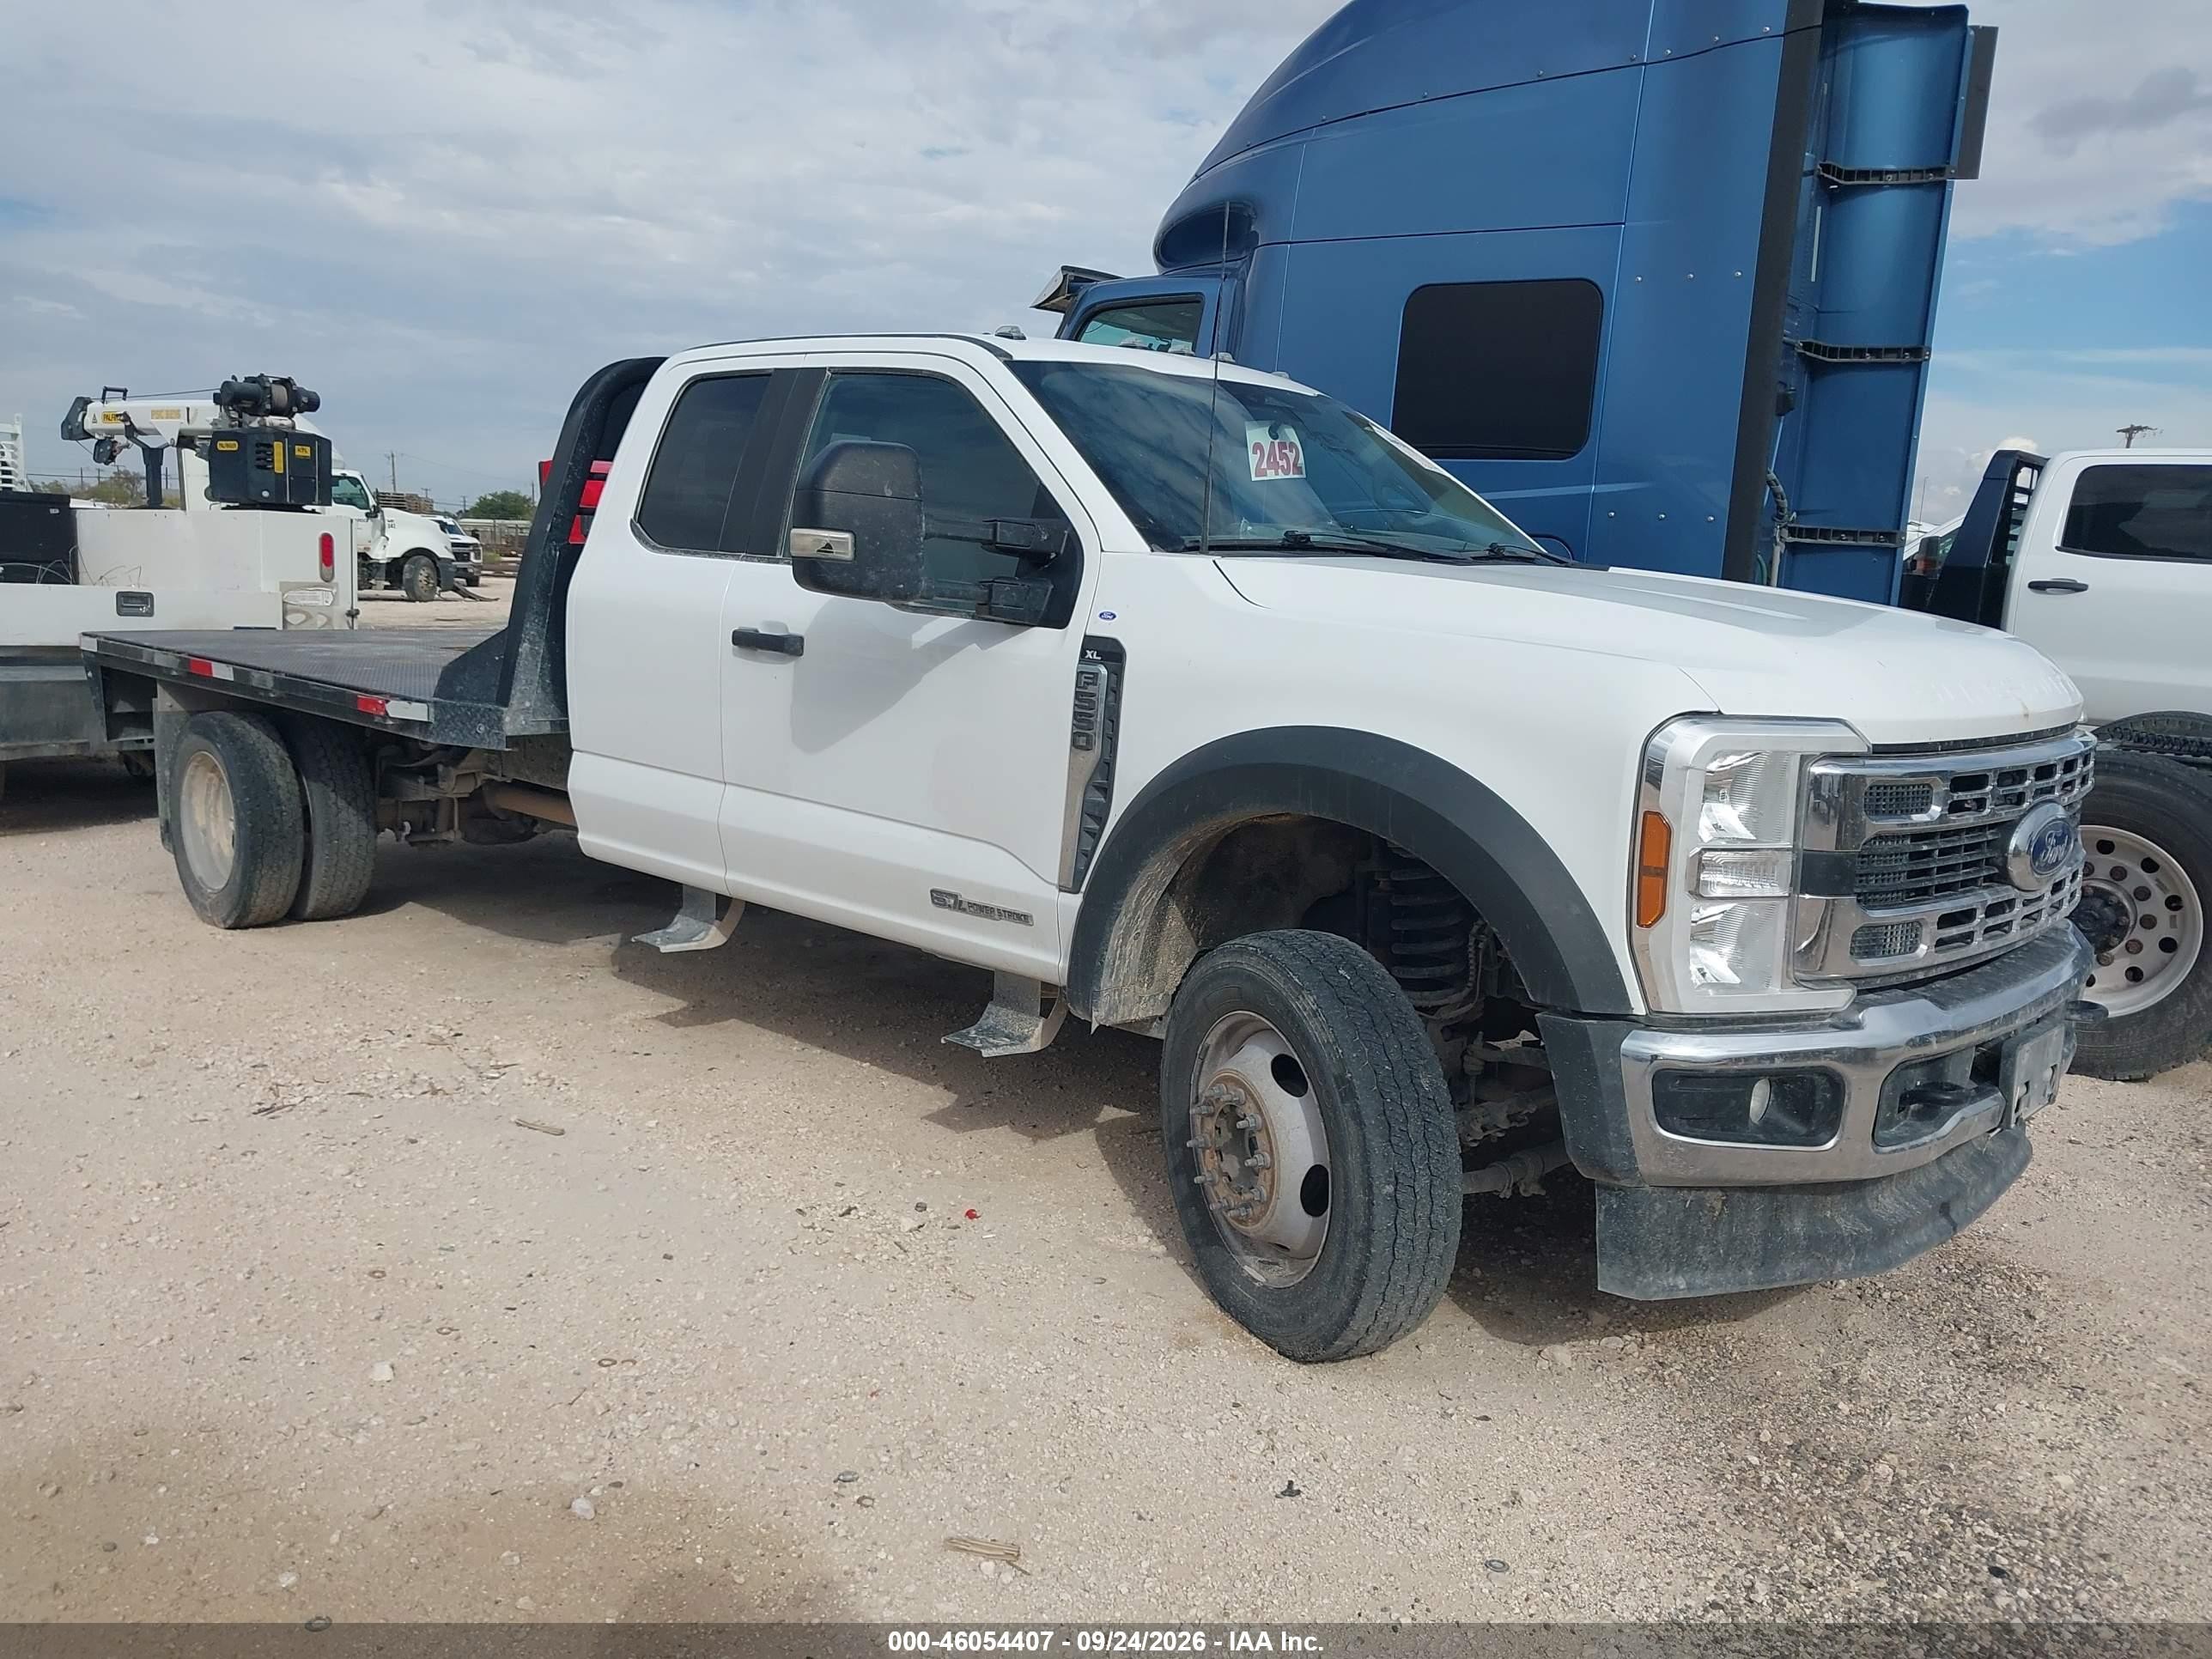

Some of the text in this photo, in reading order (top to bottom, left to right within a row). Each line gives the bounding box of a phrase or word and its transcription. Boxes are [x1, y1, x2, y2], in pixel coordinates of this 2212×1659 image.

[1252, 441, 1304, 477] 2452
[1085, 650, 1102, 660] XL
[2040, 830, 2069, 864] Ford
